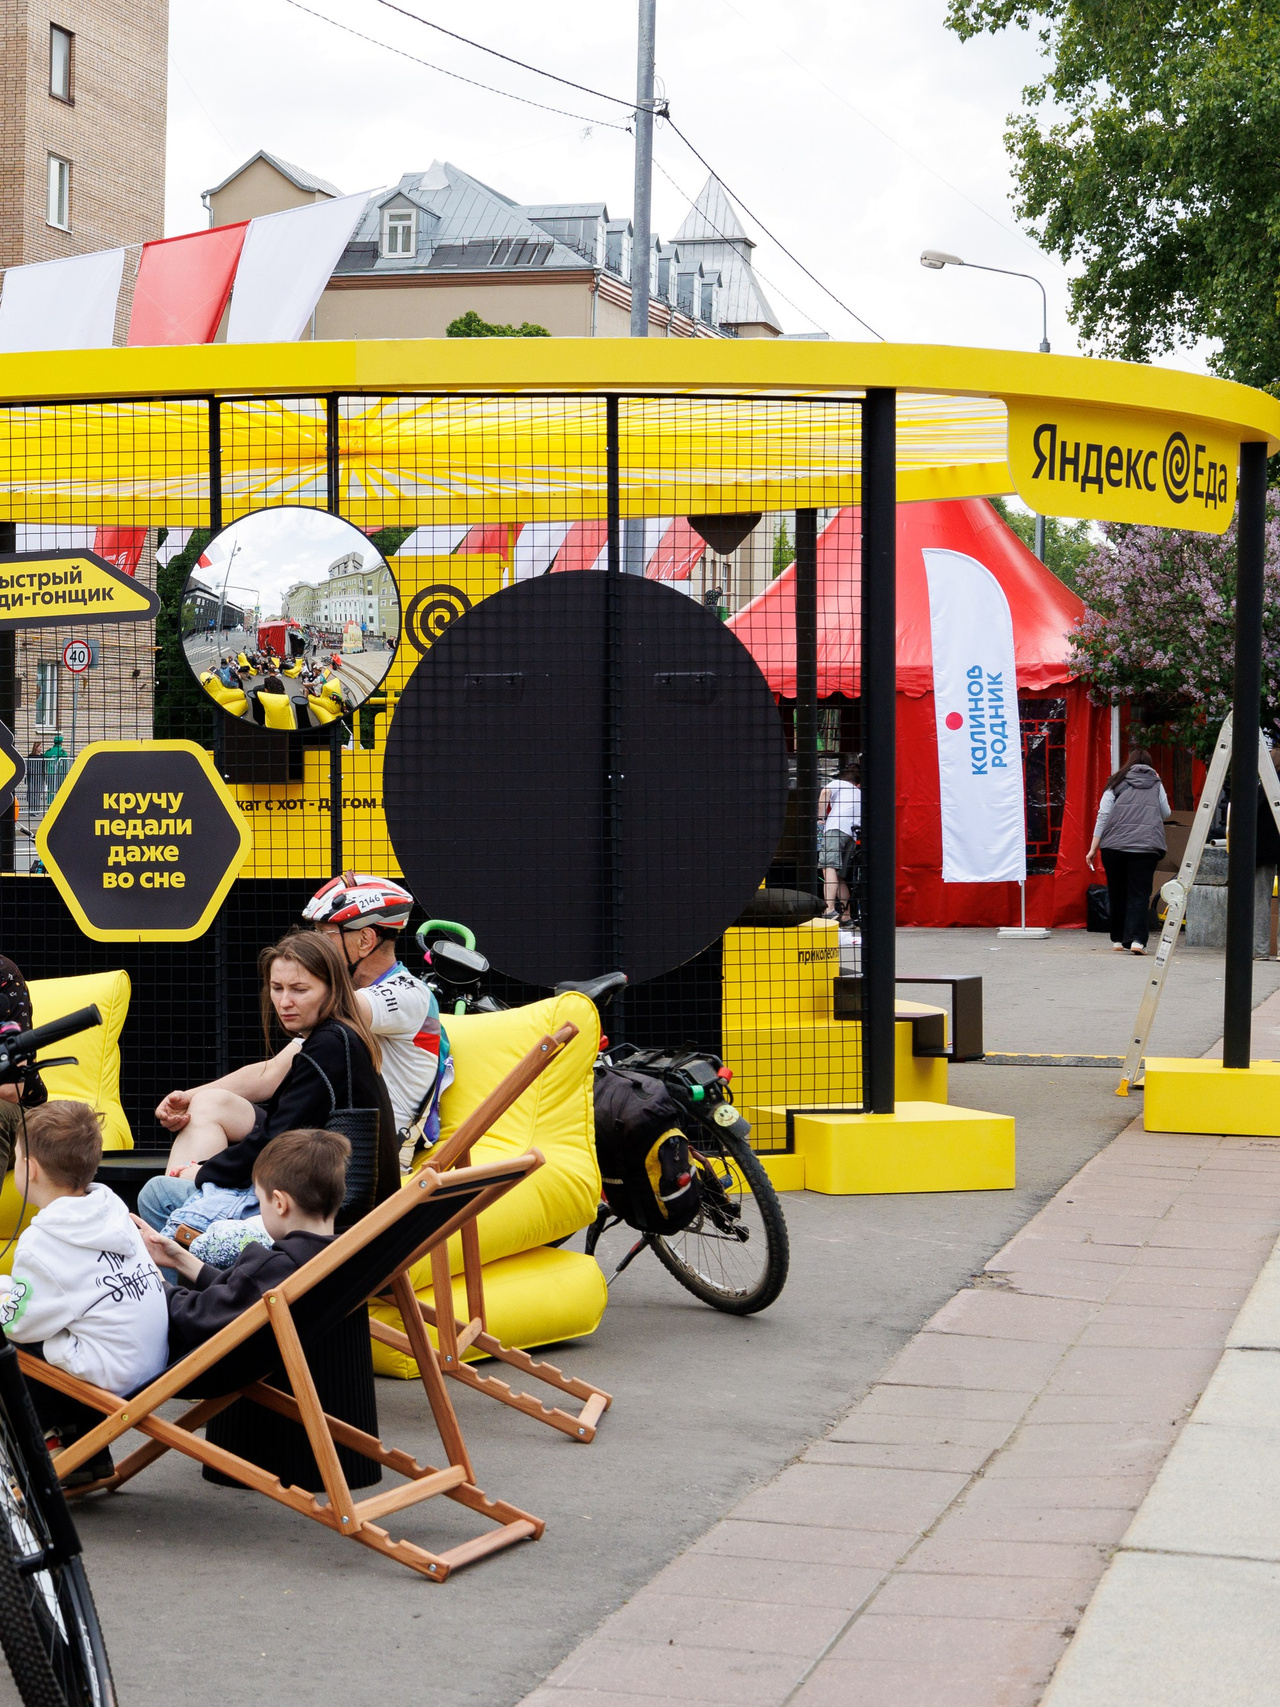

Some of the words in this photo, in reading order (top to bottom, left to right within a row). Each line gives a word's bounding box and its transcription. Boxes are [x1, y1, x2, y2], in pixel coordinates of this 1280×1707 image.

[1030, 423, 1158, 492] Яндекс
[1193, 444, 1227, 509] Еда
[69, 651, 86, 664] 40
[102, 792, 184, 818] кручу
[318, 797, 377, 812] дгом
[94, 817, 193, 841] педали
[108, 843, 180, 867] даже
[102, 870, 135, 890] во
[139, 870, 186, 890] сне
[358, 894, 381, 909] 2146
